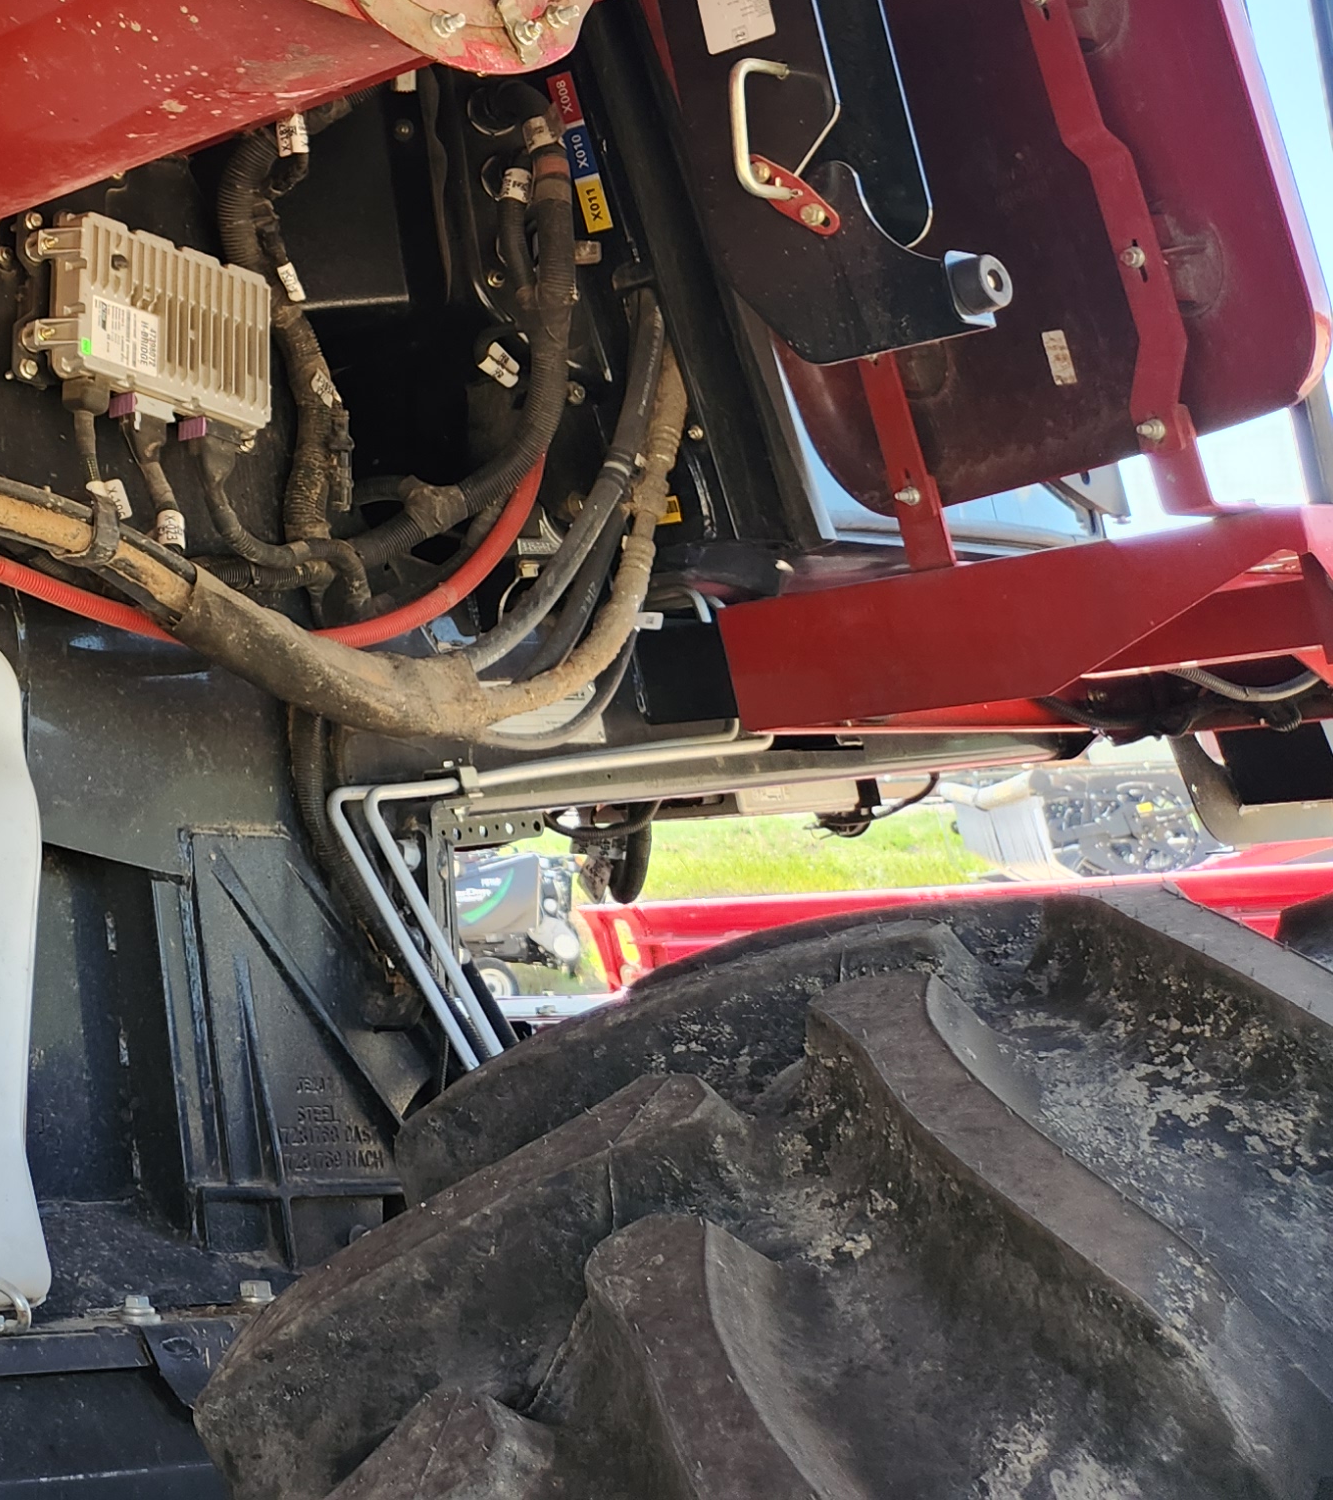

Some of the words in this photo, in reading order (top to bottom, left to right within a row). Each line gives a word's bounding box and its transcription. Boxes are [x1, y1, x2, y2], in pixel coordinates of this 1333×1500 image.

[556, 80, 574, 113] X008
[571, 134, 589, 168] X010
[586, 187, 603, 221] X011
[140, 320, 149, 366] H-BRIDGE
[297, 1104, 340, 1124] STEEL
[346, 1149, 384, 1169] MACH
